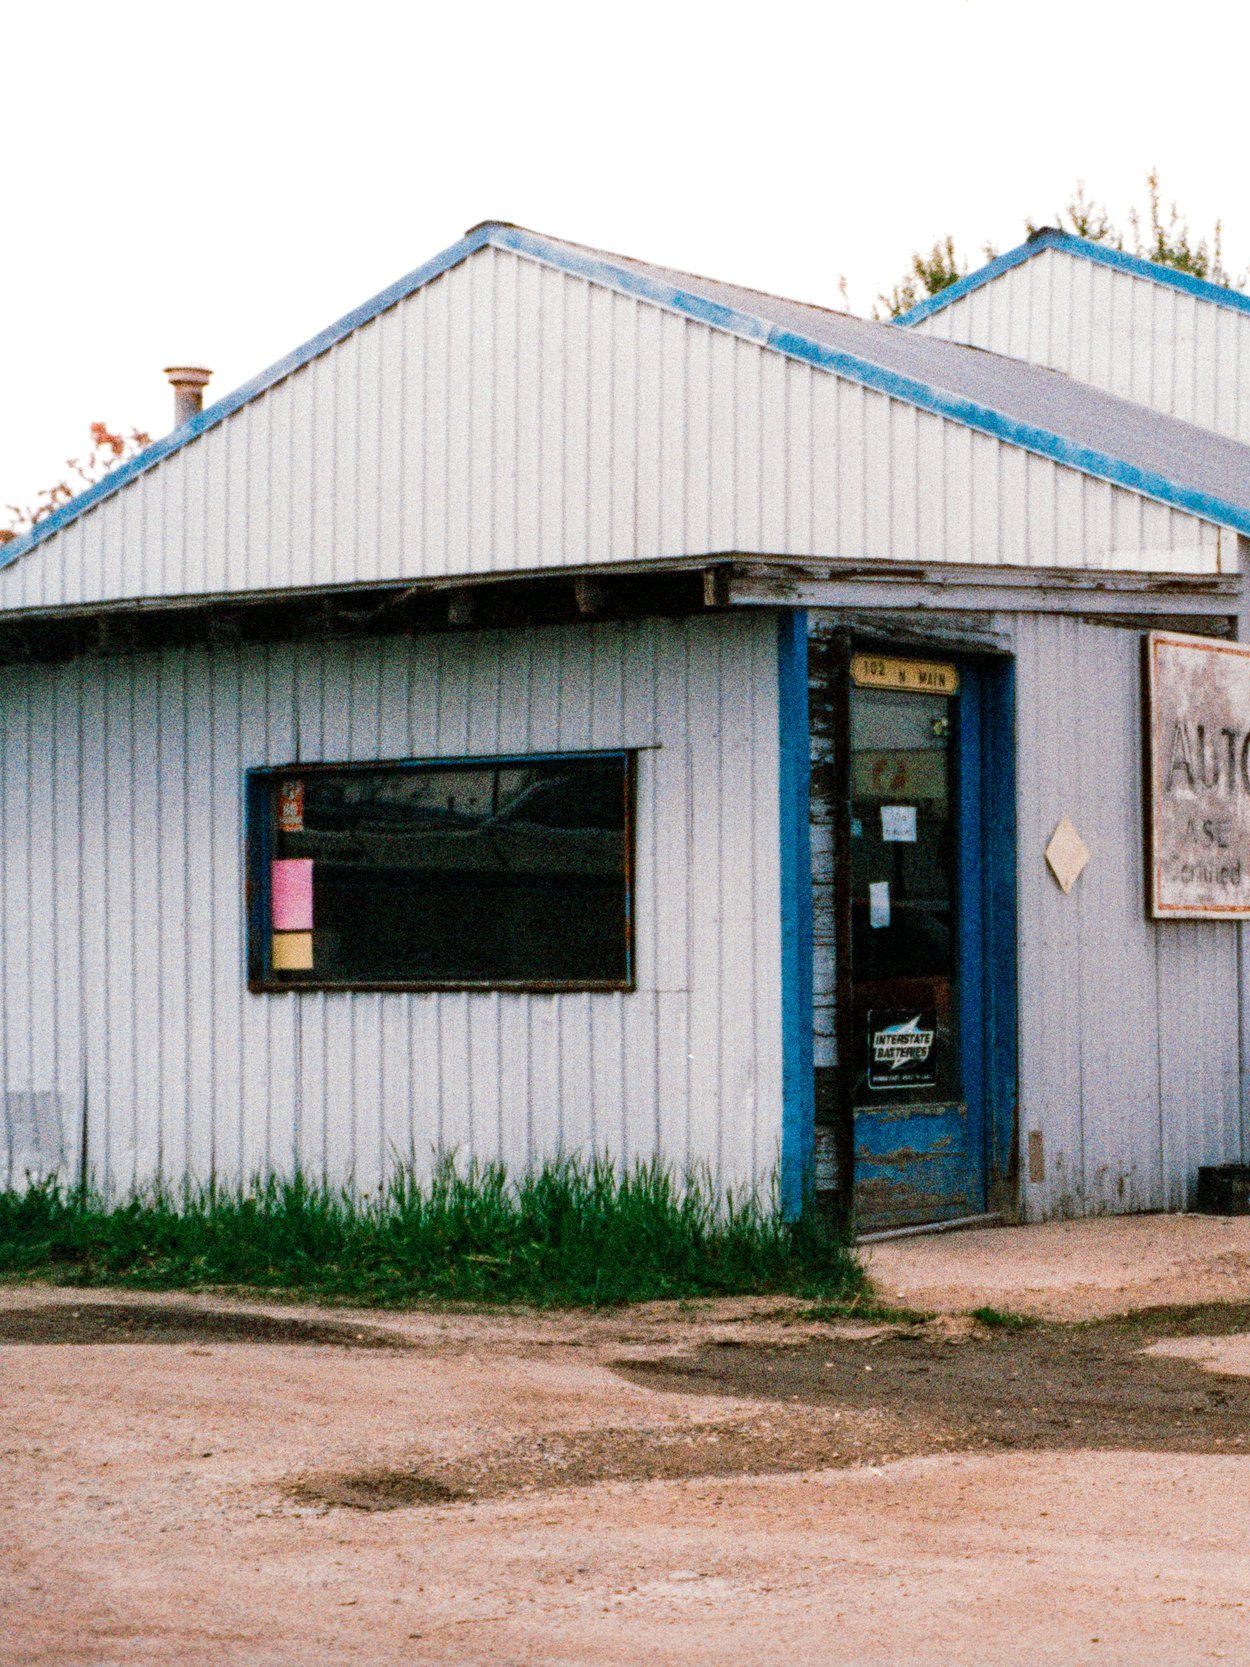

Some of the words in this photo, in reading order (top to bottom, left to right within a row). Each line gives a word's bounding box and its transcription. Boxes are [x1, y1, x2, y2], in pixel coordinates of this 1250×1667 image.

[862, 660, 885, 676] 102
[898, 669, 906, 683] N
[918, 671, 946, 687] MAIN
[876, 1033, 931, 1045] INTERSTATE
[877, 1046, 927, 1059] BATTERIES
